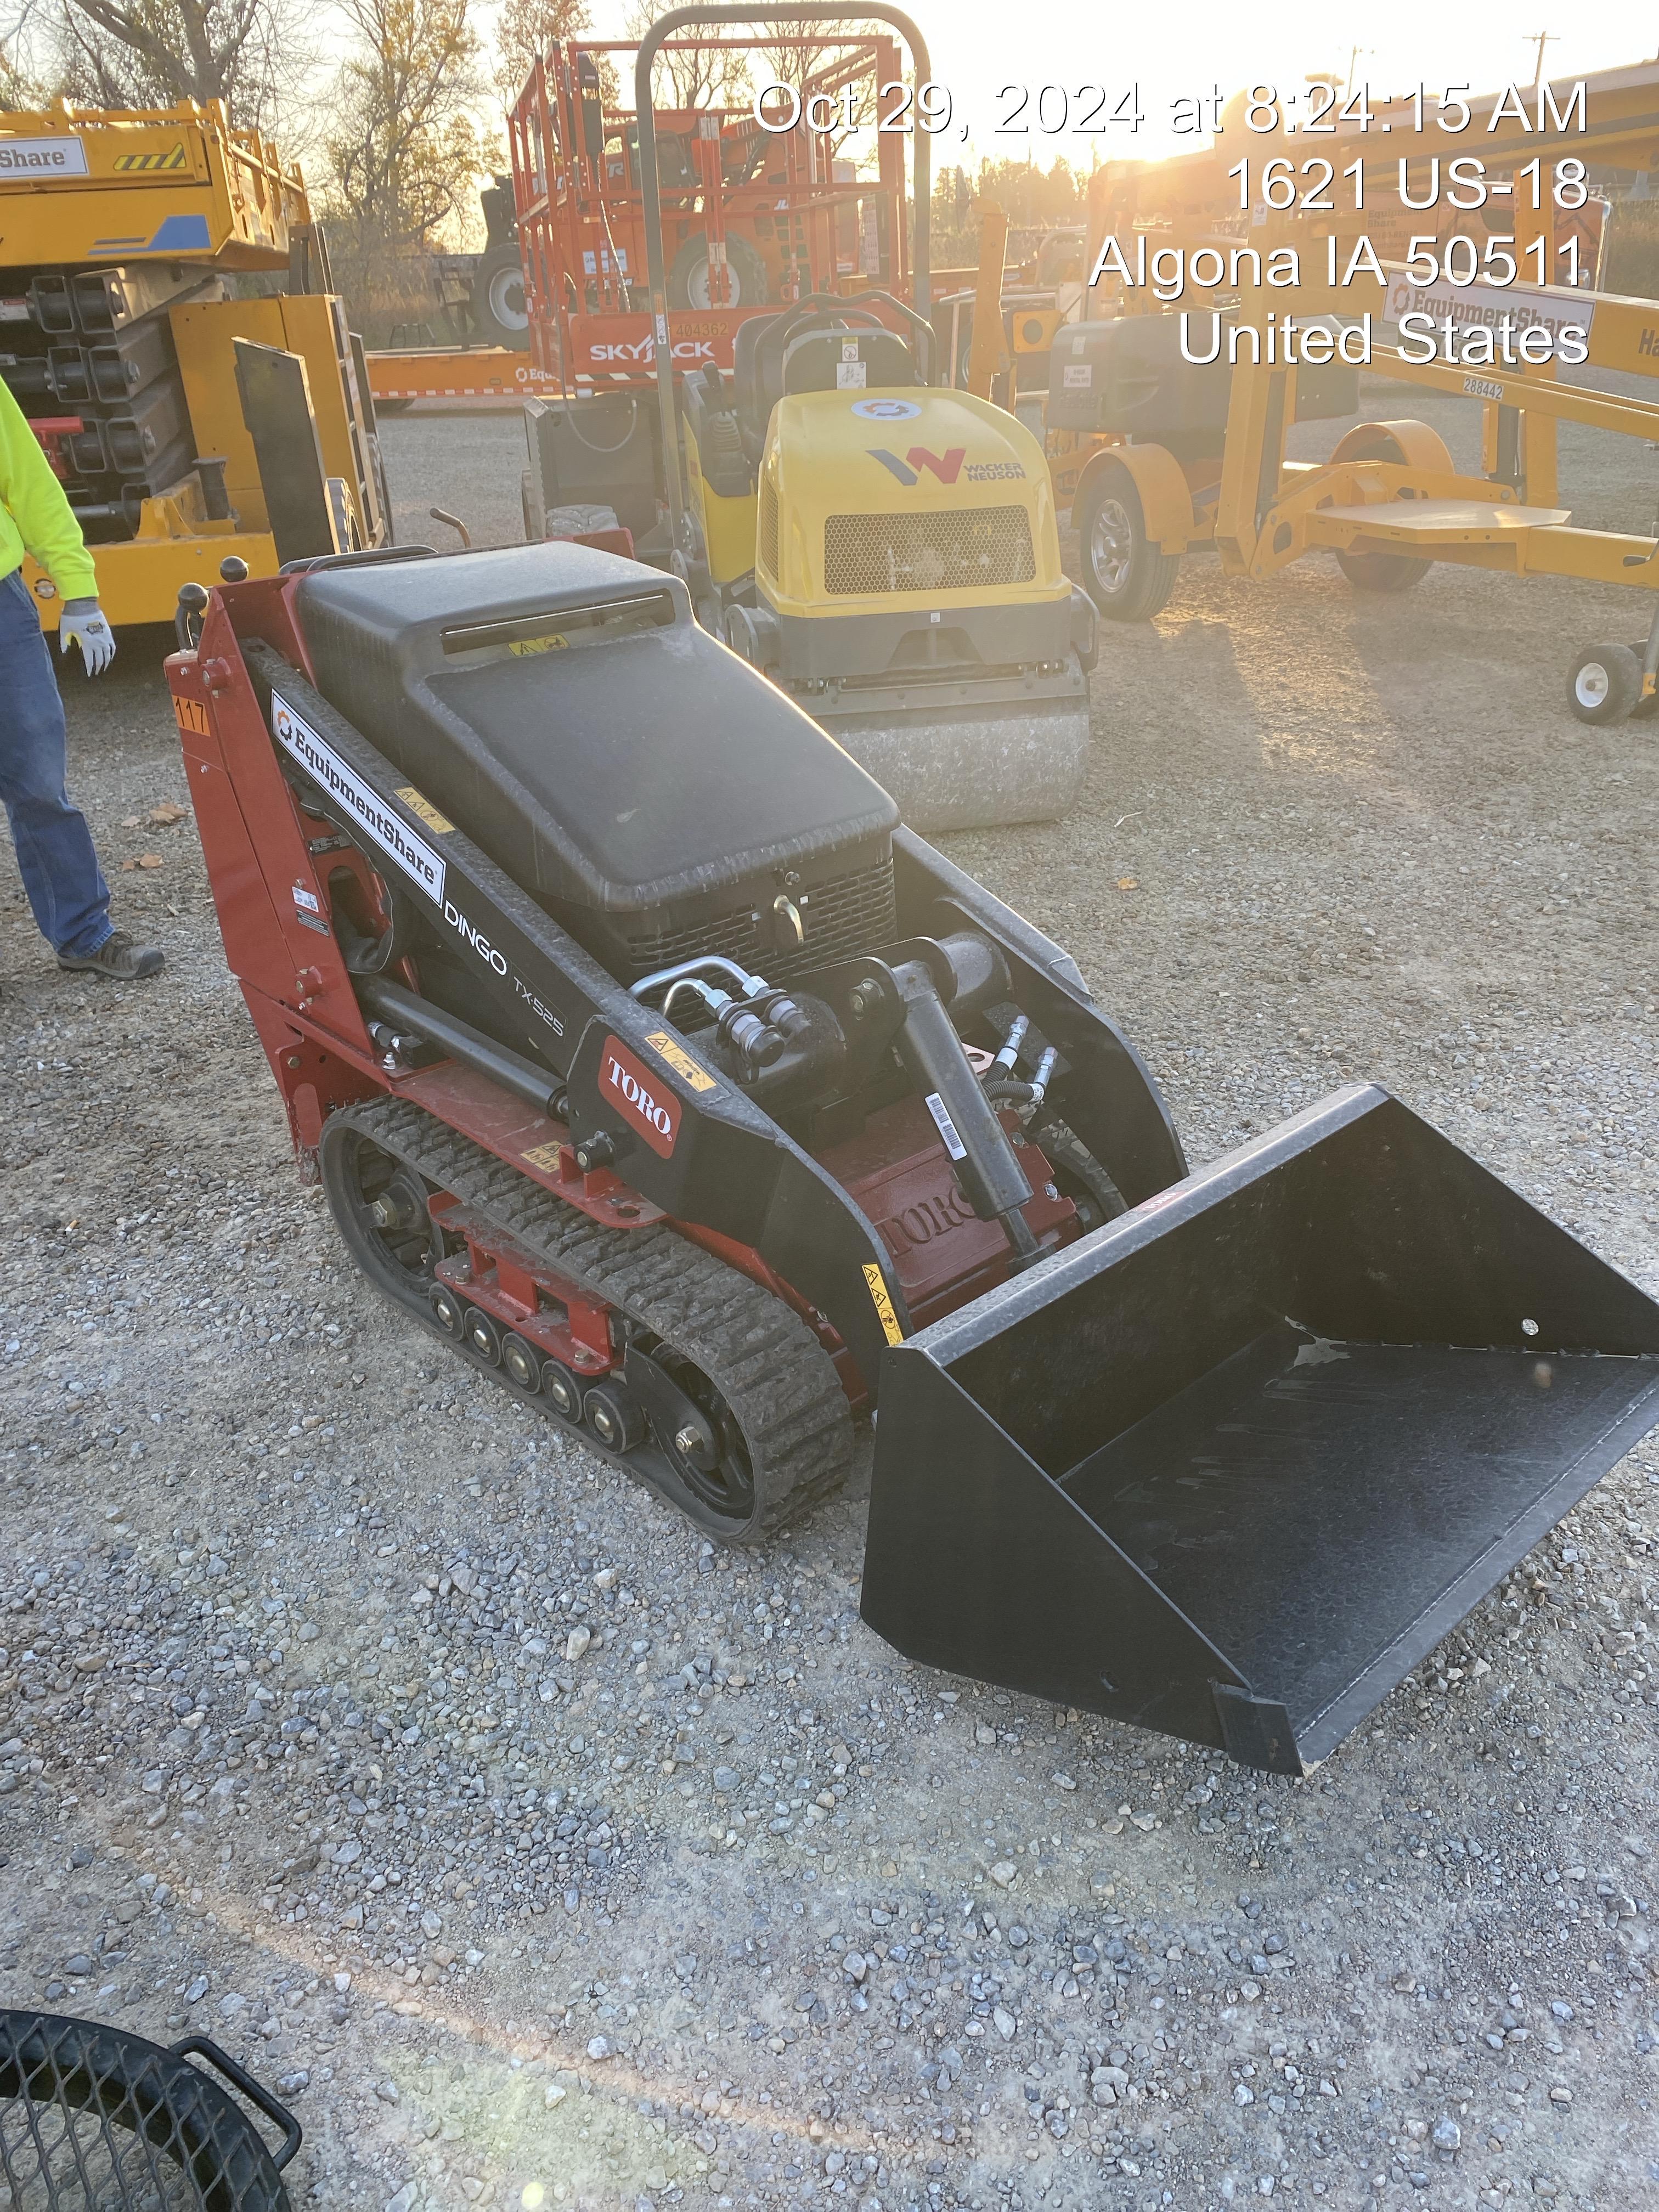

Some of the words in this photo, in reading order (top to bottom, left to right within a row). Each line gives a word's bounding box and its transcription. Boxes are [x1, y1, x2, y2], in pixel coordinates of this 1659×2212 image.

[676, 323, 728, 336] 404362
[1412, 289, 1578, 341] EquipmentShare
[1464, 377, 1503, 400] 288442
[963, 462, 1023, 473] WACKER
[967, 470, 1026, 481] NEUSON
[176, 697, 204, 733] 117
[294, 727, 435, 885] EquipmentShare
[444, 900, 507, 975] DINGO
[608, 1056, 672, 1135] TORO
